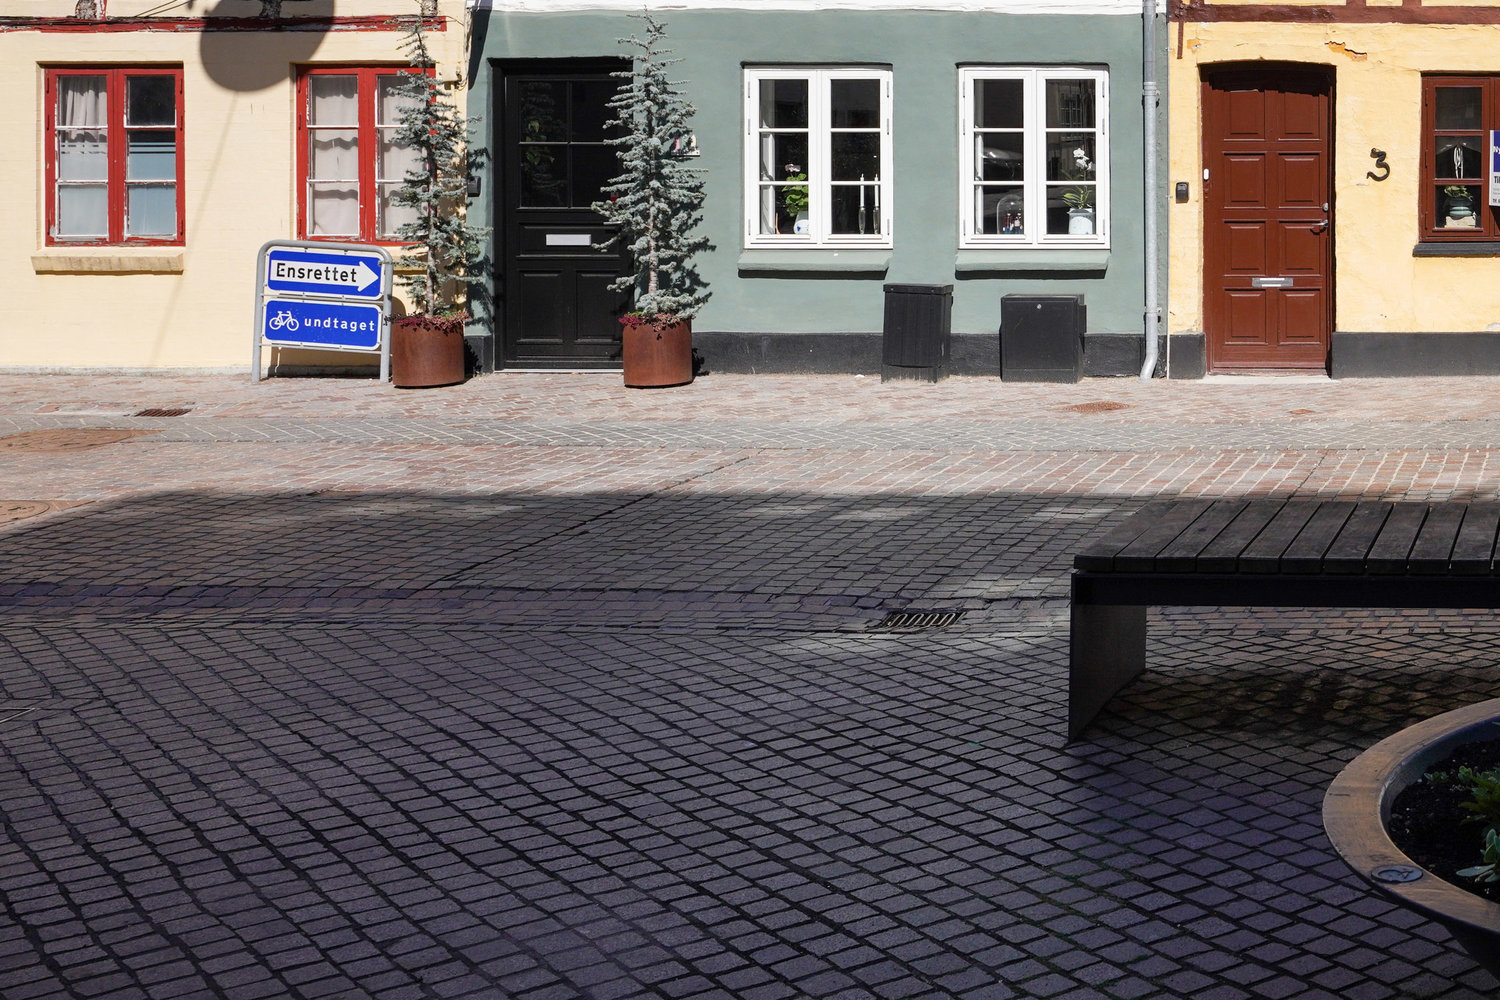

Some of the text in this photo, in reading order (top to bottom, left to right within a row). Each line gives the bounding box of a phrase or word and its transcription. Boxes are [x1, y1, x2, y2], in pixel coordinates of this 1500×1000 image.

[1366, 147, 1391, 182] 3
[276, 262, 357, 282] Ensrettet
[304, 317, 375, 332] undtaget
